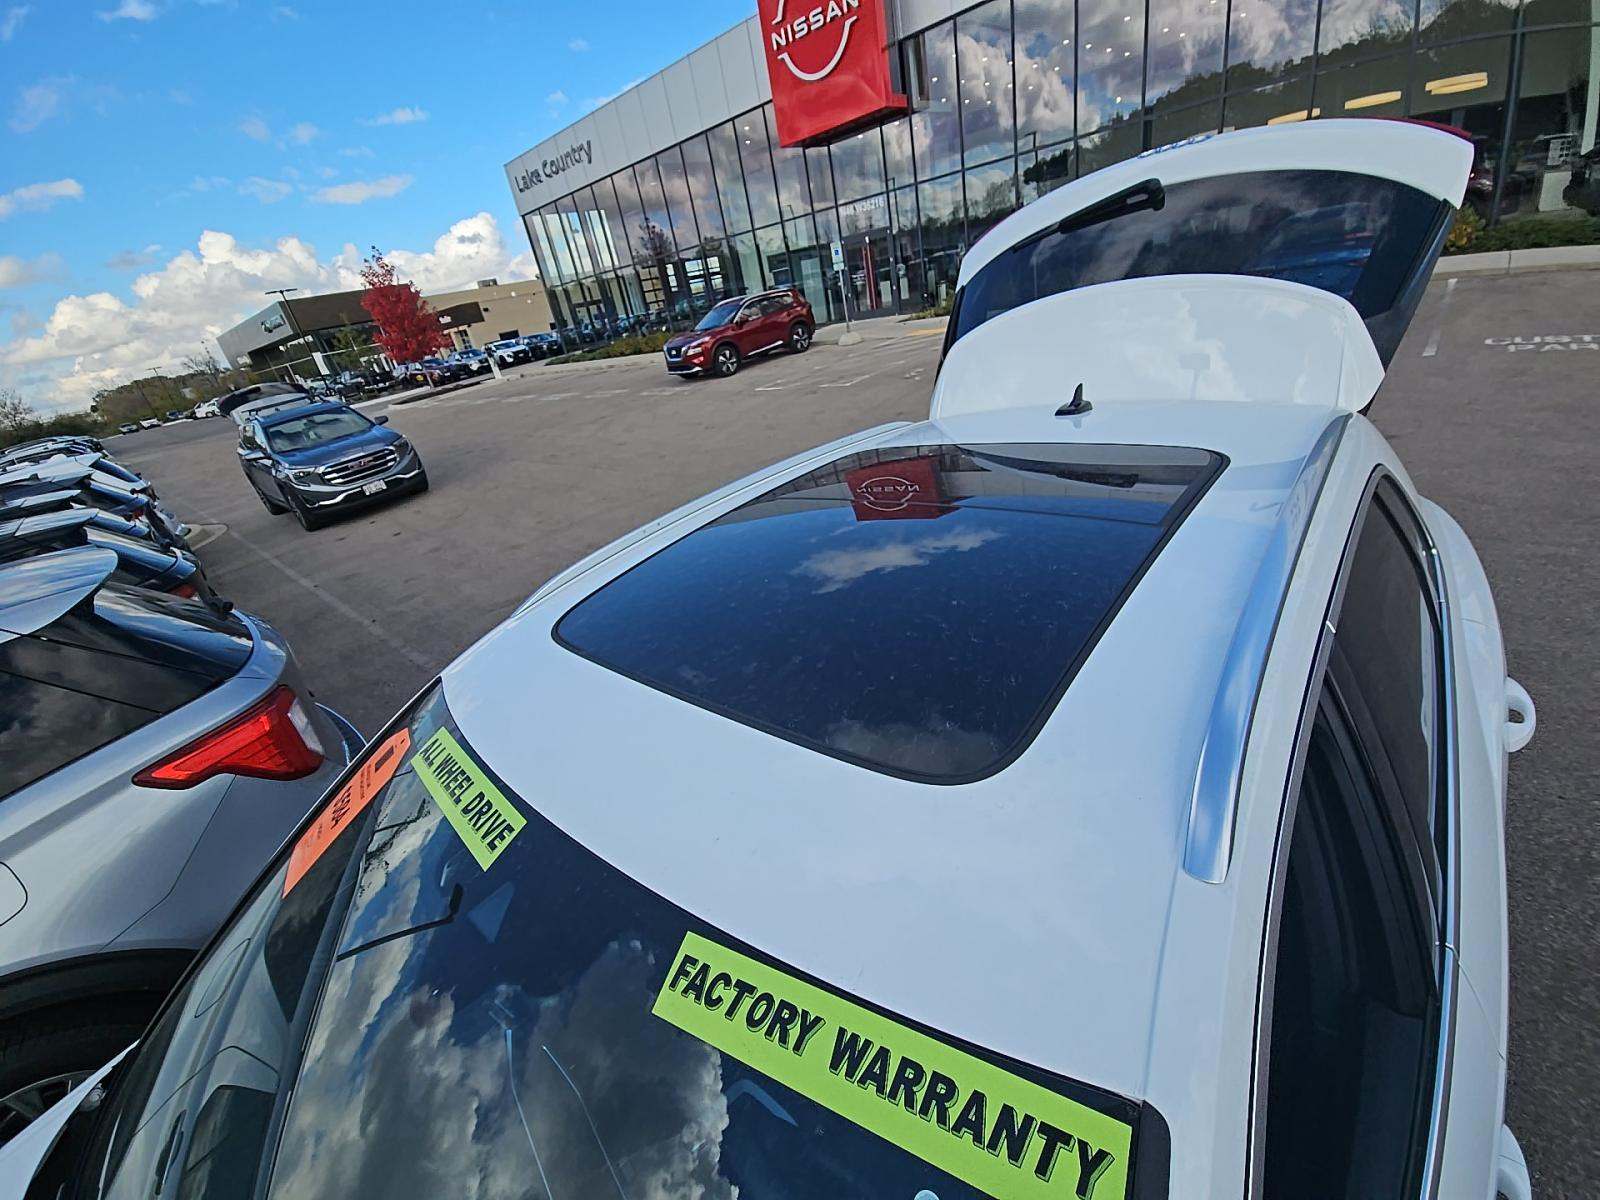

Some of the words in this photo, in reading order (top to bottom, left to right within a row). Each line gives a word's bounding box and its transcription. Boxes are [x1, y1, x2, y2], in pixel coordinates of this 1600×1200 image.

[771, 0, 859, 51] NISSAN
[514, 169, 544, 194] Lake
[542, 139, 593, 179] Country
[418, 738, 444, 769] ALL
[432, 752, 475, 806] WHEEL
[460, 790, 516, 853] DRIVE
[668, 954, 827, 1056] FACTORY
[828, 1026, 1116, 1200] WARRANTY
